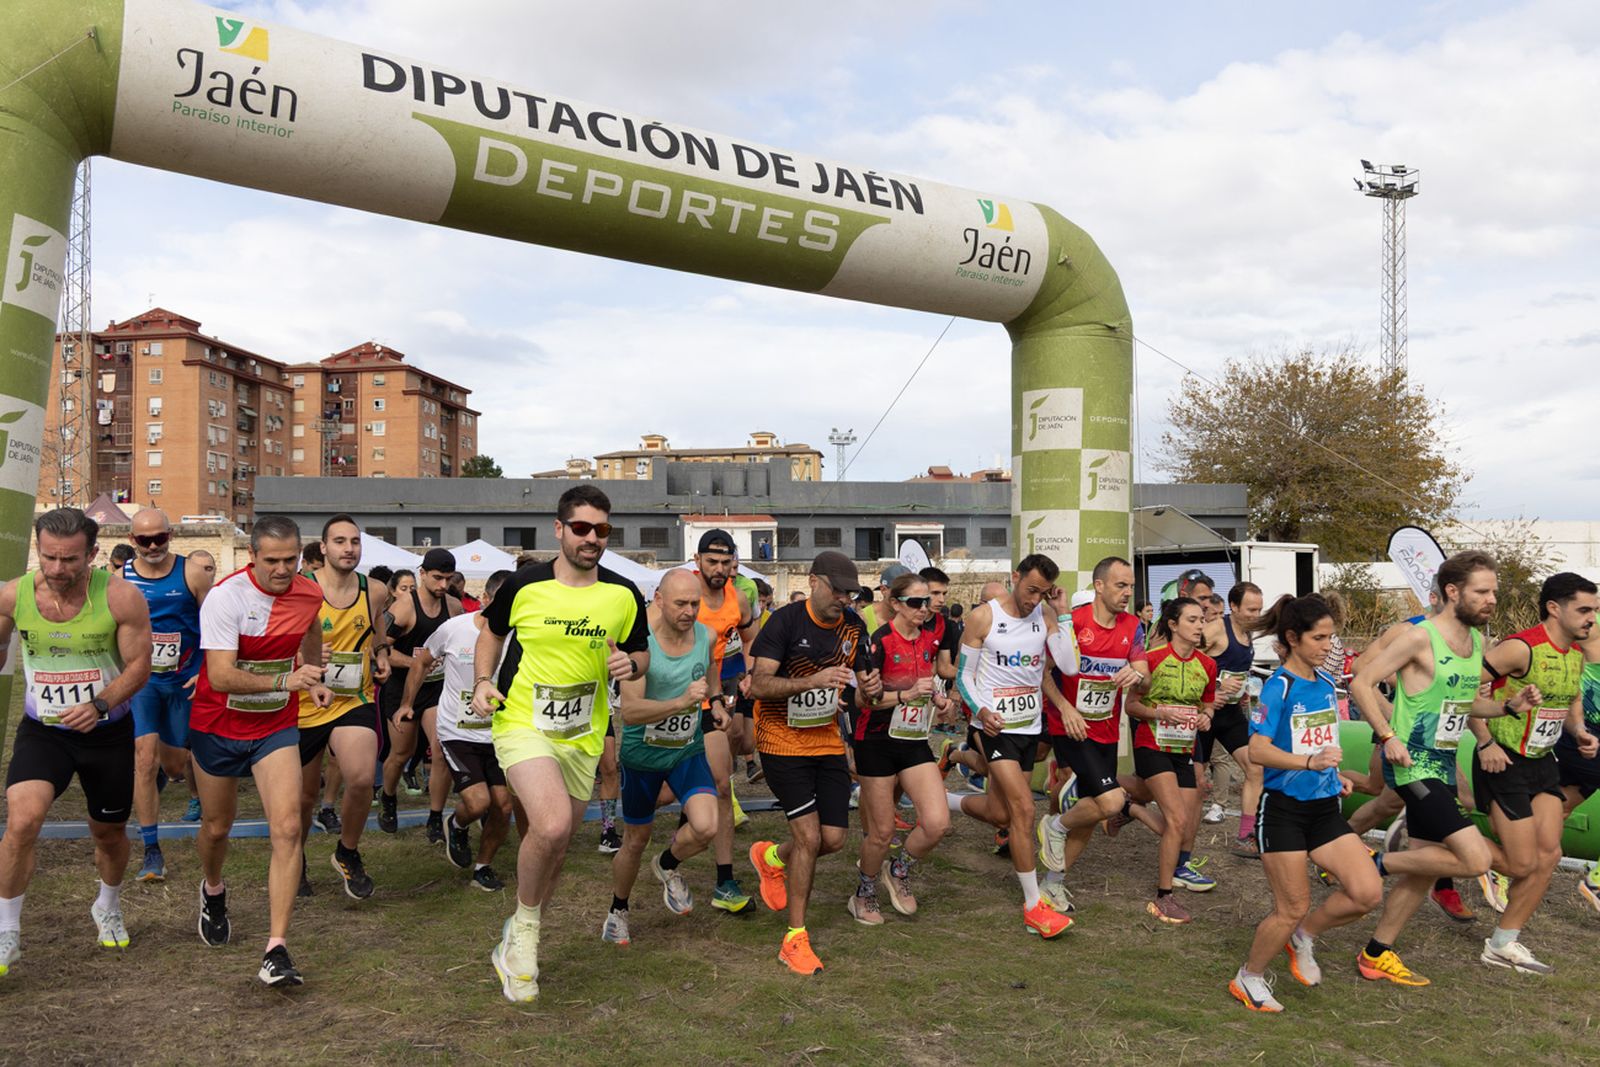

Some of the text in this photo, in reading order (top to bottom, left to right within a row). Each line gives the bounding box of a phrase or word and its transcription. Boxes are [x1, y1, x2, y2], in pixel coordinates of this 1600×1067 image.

[174, 47, 299, 122] Jaén
[172, 101, 294, 138] Paraíso interior
[361, 53, 925, 215] DIPUTACIÓN DE JAÉN
[473, 136, 840, 253] DEPORTES
[959, 228, 1031, 275] Jaén
[991, 273, 1024, 287] interior
[1038, 415, 1077, 423] DIPUTACIÓN
[564, 624, 607, 637] fondo
[996, 650, 1040, 667] indea
[334, 664, 346, 679] 7
[41, 683, 95, 704] 4111
[791, 688, 836, 708] 4037
[996, 694, 1036, 713] 4190
[1083, 691, 1110, 706] 475
[542, 697, 582, 720] 444
[654, 715, 692, 732] 286
[1301, 724, 1333, 747] 484
